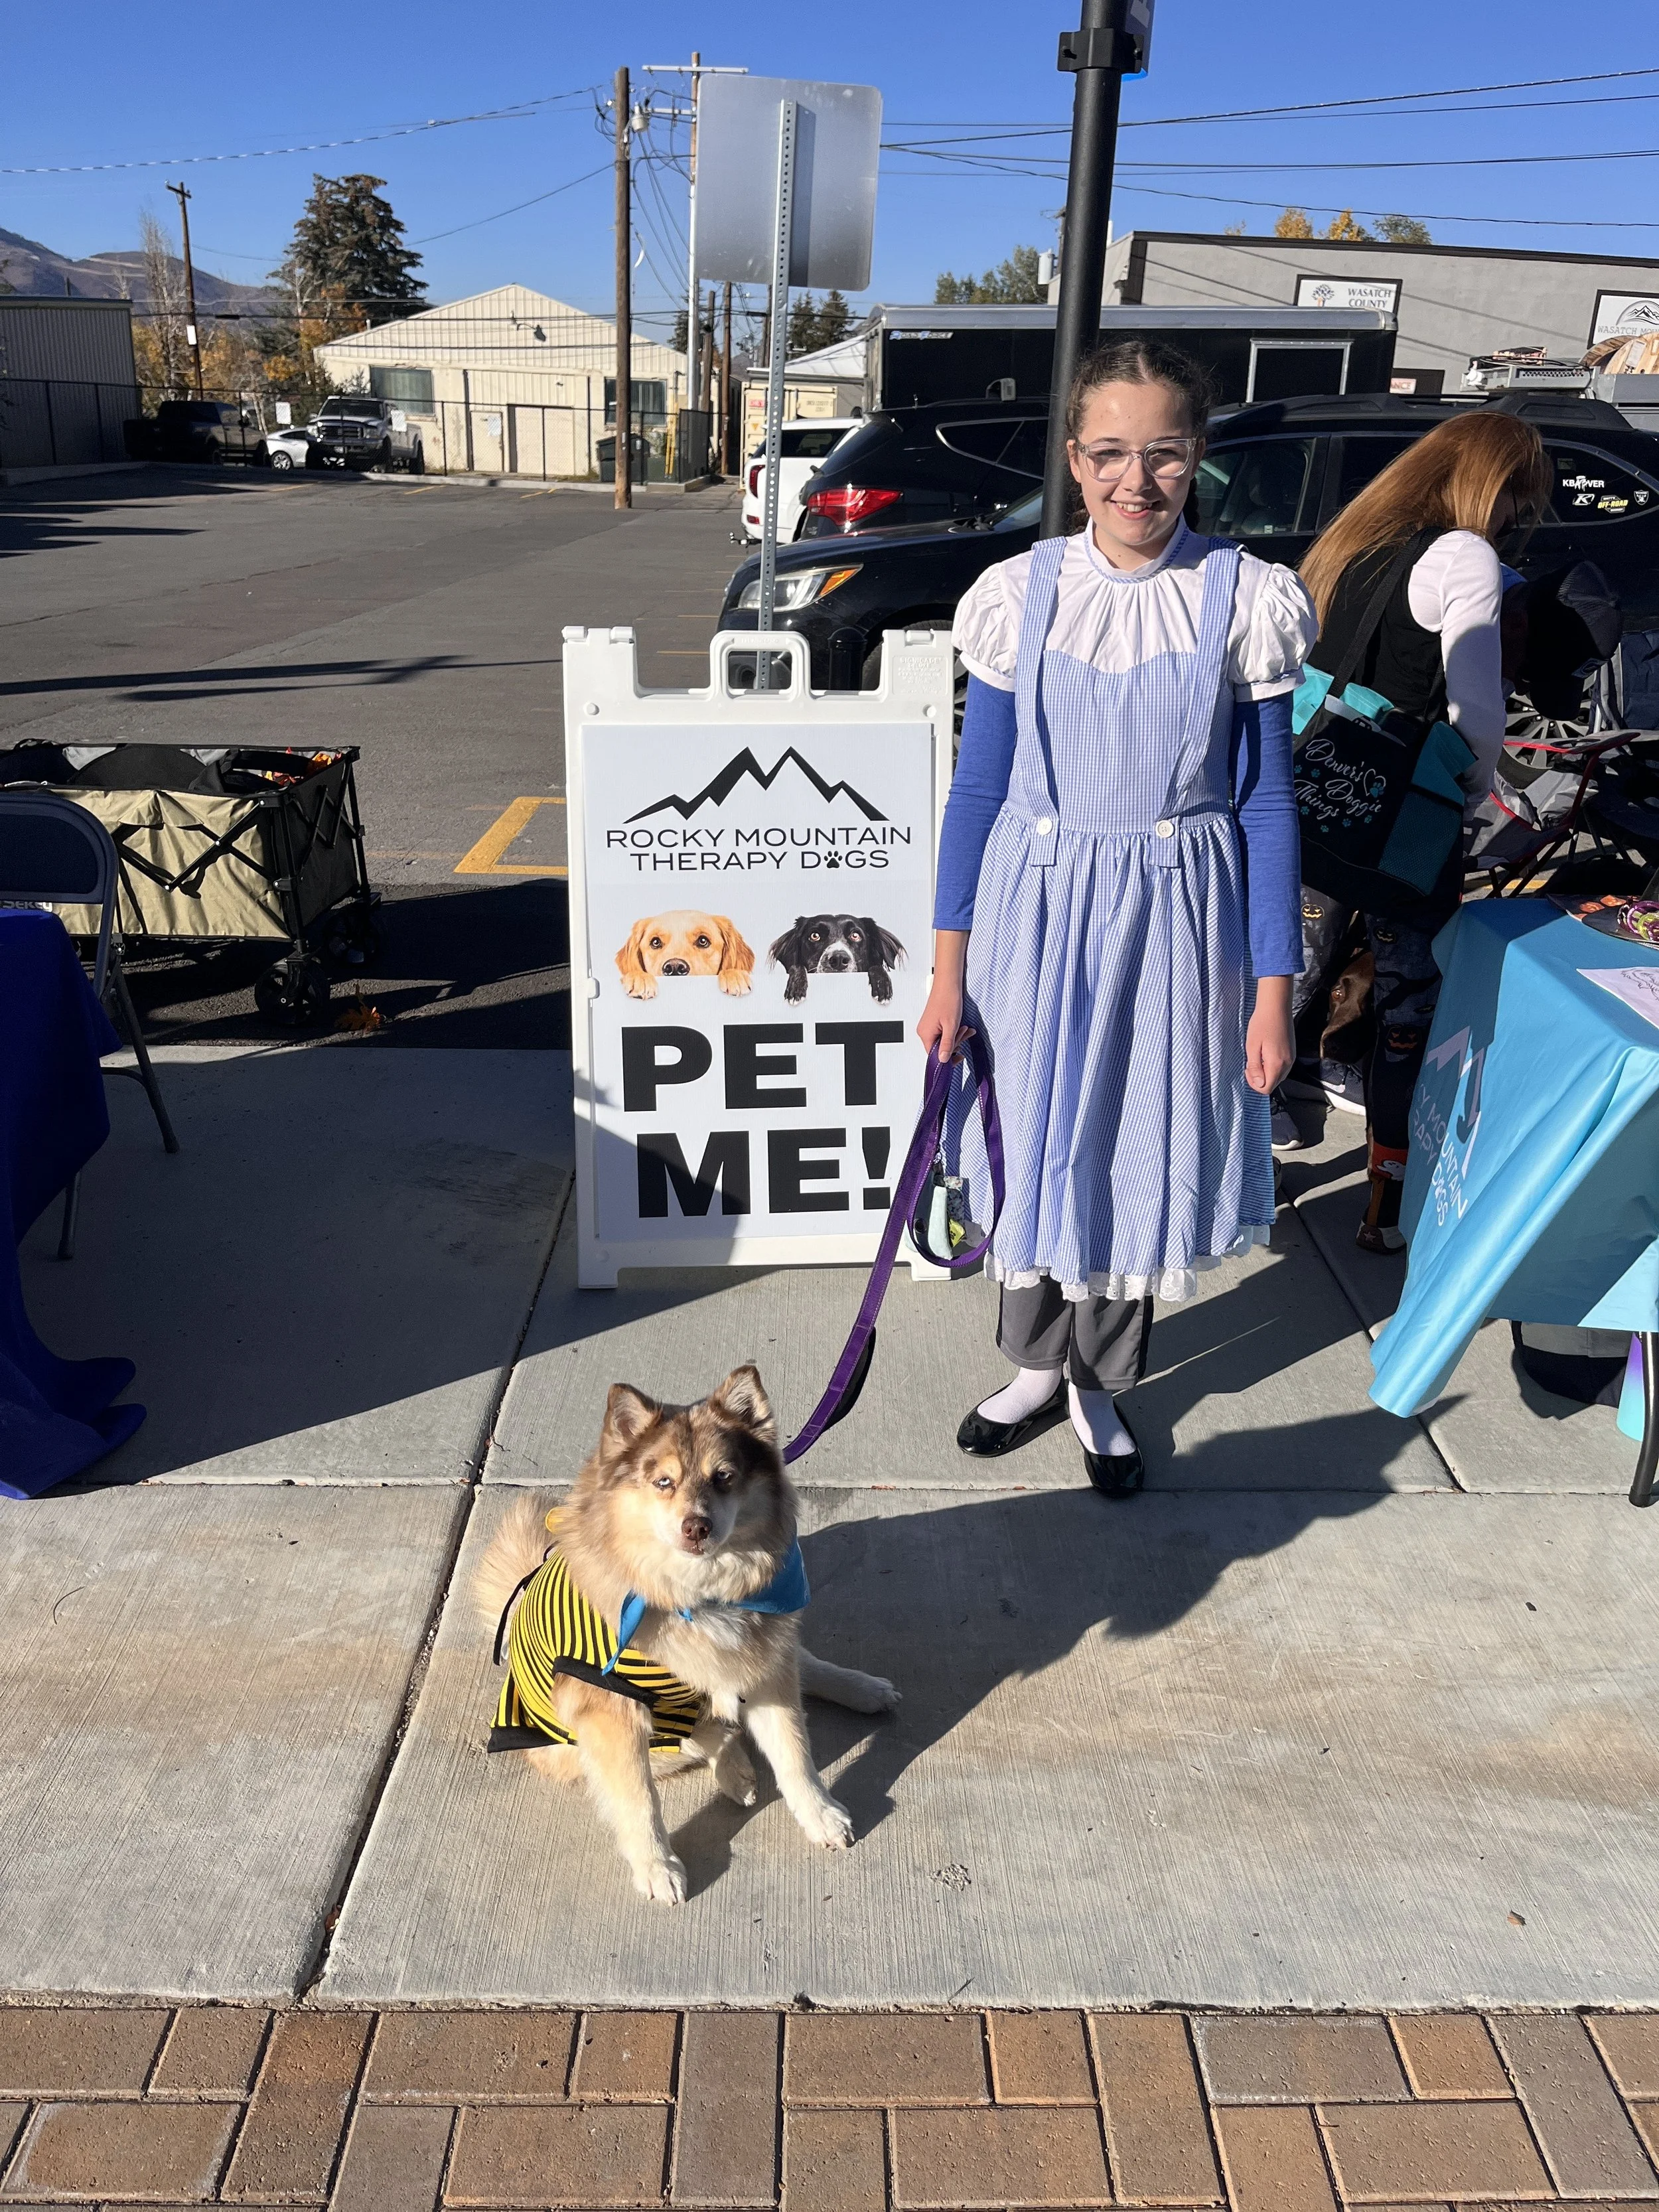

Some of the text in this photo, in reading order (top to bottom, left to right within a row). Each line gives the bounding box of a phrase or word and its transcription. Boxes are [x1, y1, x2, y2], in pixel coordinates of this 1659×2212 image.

[1348, 288, 1392, 297] WASATCH
[1348, 299, 1387, 308] COUNTY
[1597, 326, 1637, 334] WASATCH
[1597, 499, 1628, 508] OFF-ROAD
[1305, 739, 1364, 782] Denver's
[1294, 779, 1340, 820] Things
[1325, 779, 1382, 817] Doggie
[607, 827, 910, 848] ROCKY MOUNTAIN
[630, 852, 787, 871] THERAPY
[622, 1021, 903, 1112] PET
[637, 1127, 890, 1218] ME!
[1427, 1102, 1468, 1220] MOUNTAIN
